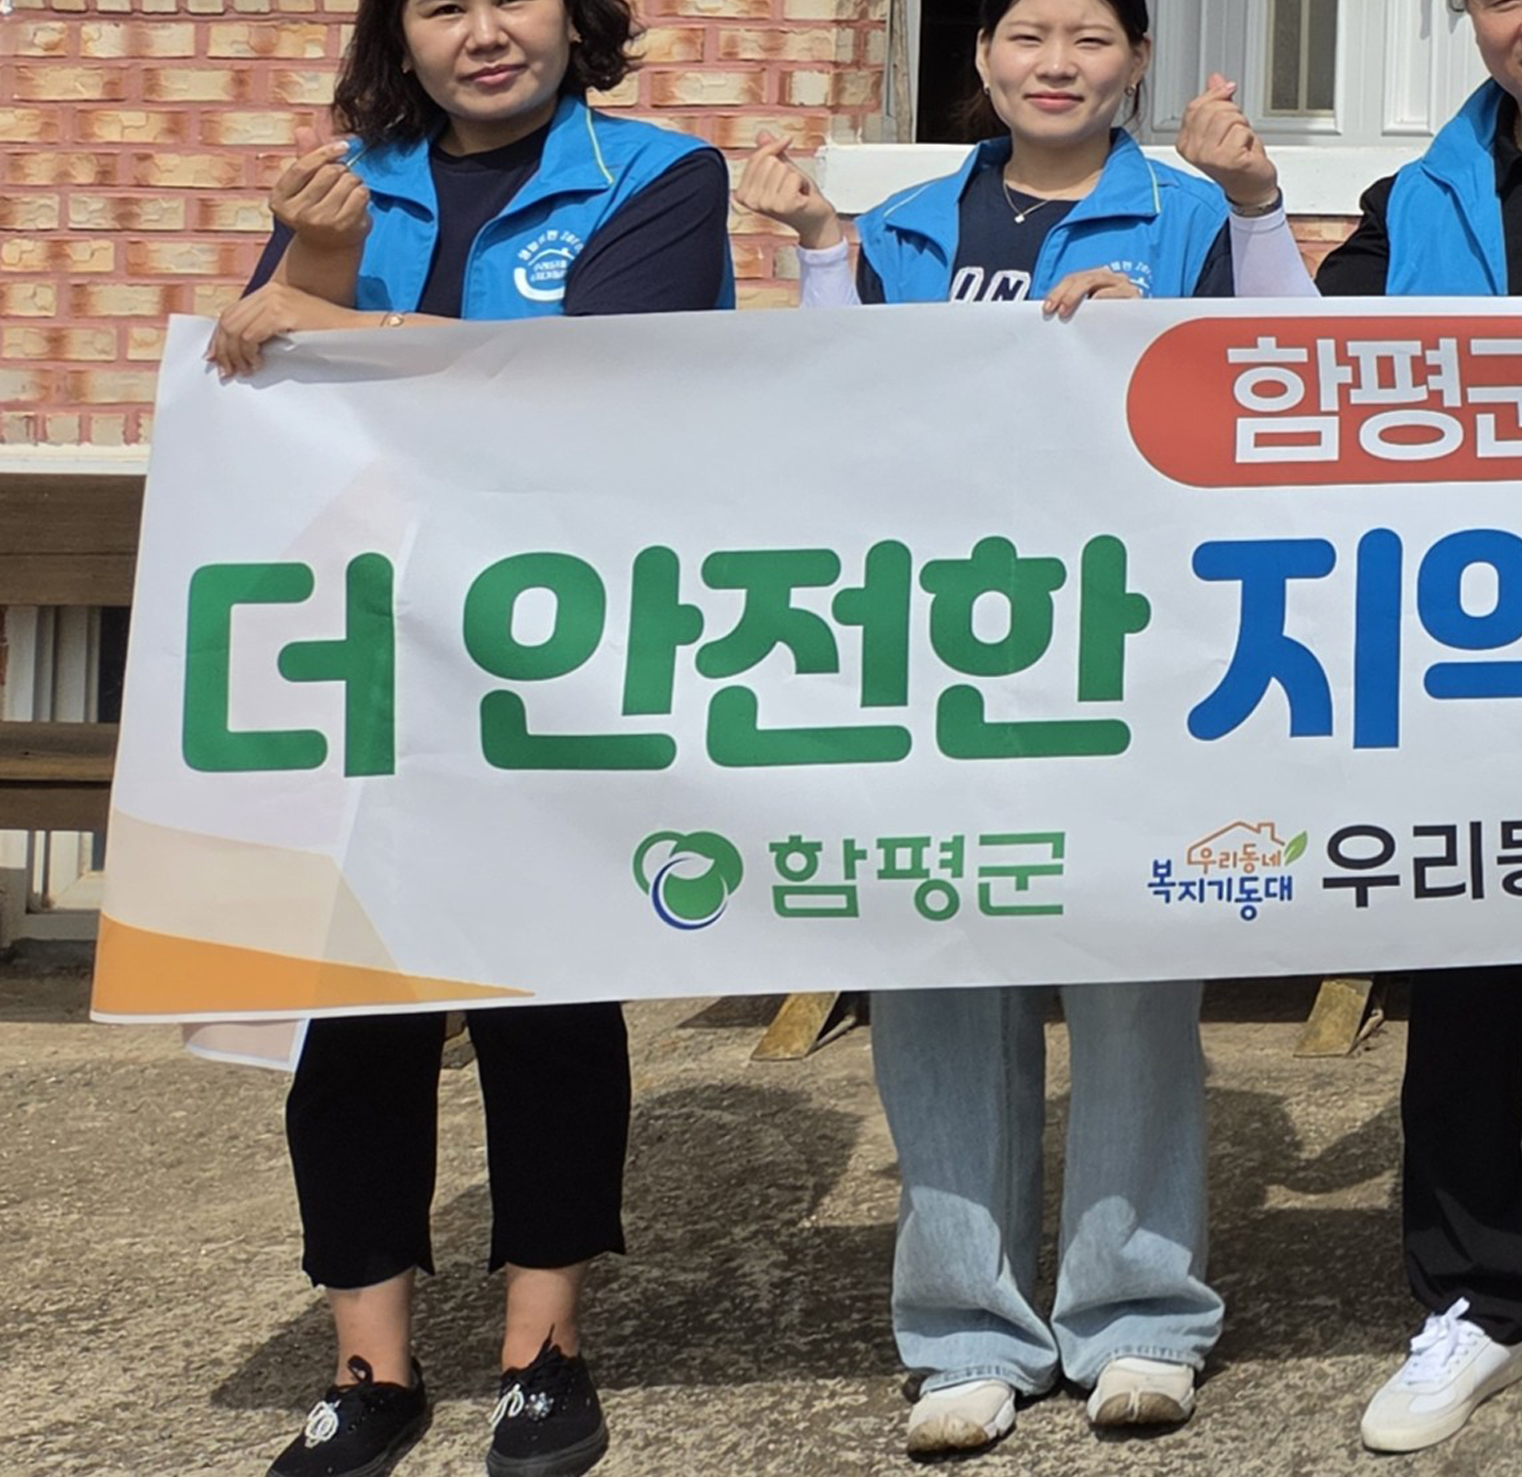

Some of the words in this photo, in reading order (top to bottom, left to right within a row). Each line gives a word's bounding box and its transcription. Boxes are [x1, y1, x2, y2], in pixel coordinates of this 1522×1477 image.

[181, 551, 396, 779] 더
[462, 534, 1151, 772] 안전한
[767, 830, 1066, 922] 함평군
[1147, 858, 1293, 921] 복지기동대
[1198, 843, 1282, 875] 우리동네
